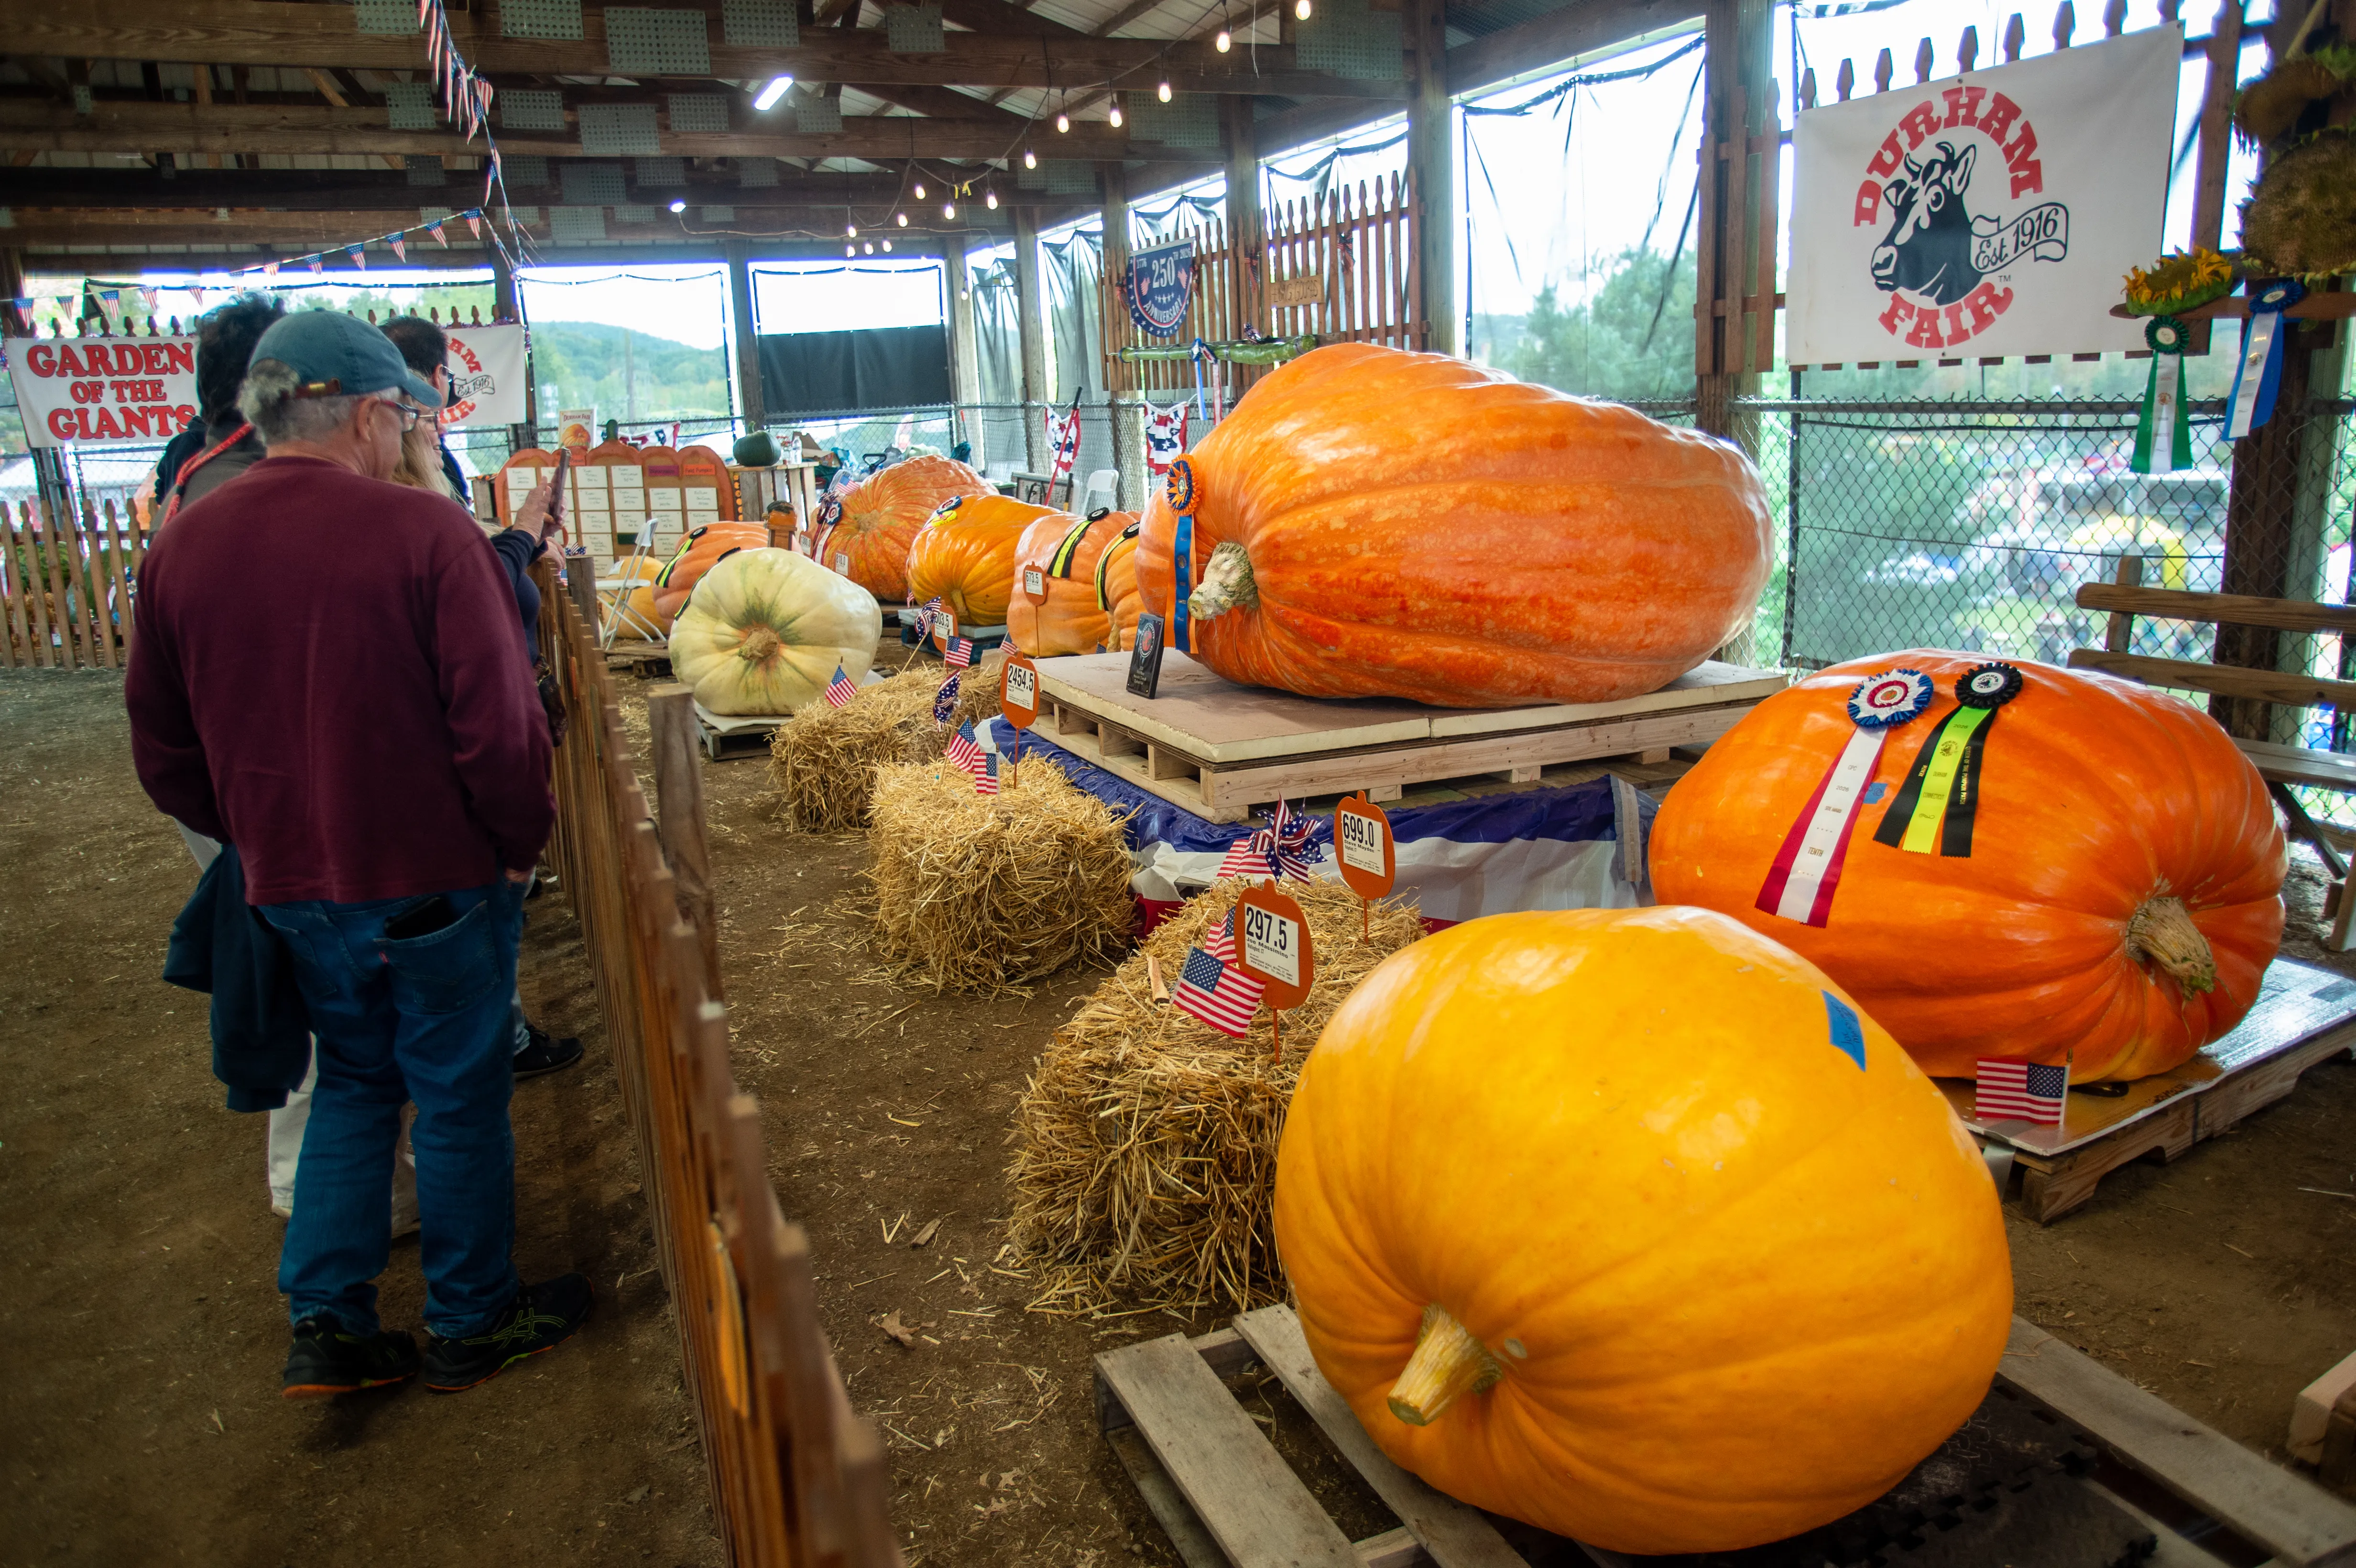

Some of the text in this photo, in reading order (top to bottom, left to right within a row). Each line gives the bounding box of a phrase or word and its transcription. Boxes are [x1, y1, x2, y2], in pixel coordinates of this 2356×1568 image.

[1854, 86, 2043, 228] DURHAM
[2012, 207, 2059, 254] 1916
[1136, 258, 1147, 269] 1776
[1997, 274, 2012, 283] TM
[1143, 294, 1182, 323] ANNIVERSARY
[1878, 282, 2014, 348] FAIR
[26, 343, 195, 378] GARDEN
[70, 379, 167, 404] OF THE
[48, 404, 196, 441] GIANTS
[836, 554, 846, 566] 818.0
[1026, 571, 1039, 584] 673.5
[1008, 665, 1034, 692] 2454.5
[1343, 814, 1374, 848] 699.0
[1344, 839, 1374, 853] Steve Mayden
[1808, 847, 1824, 857] TENTH
[1246, 906, 1287, 951] 297.5
[1258, 942, 1288, 958] Massimino
